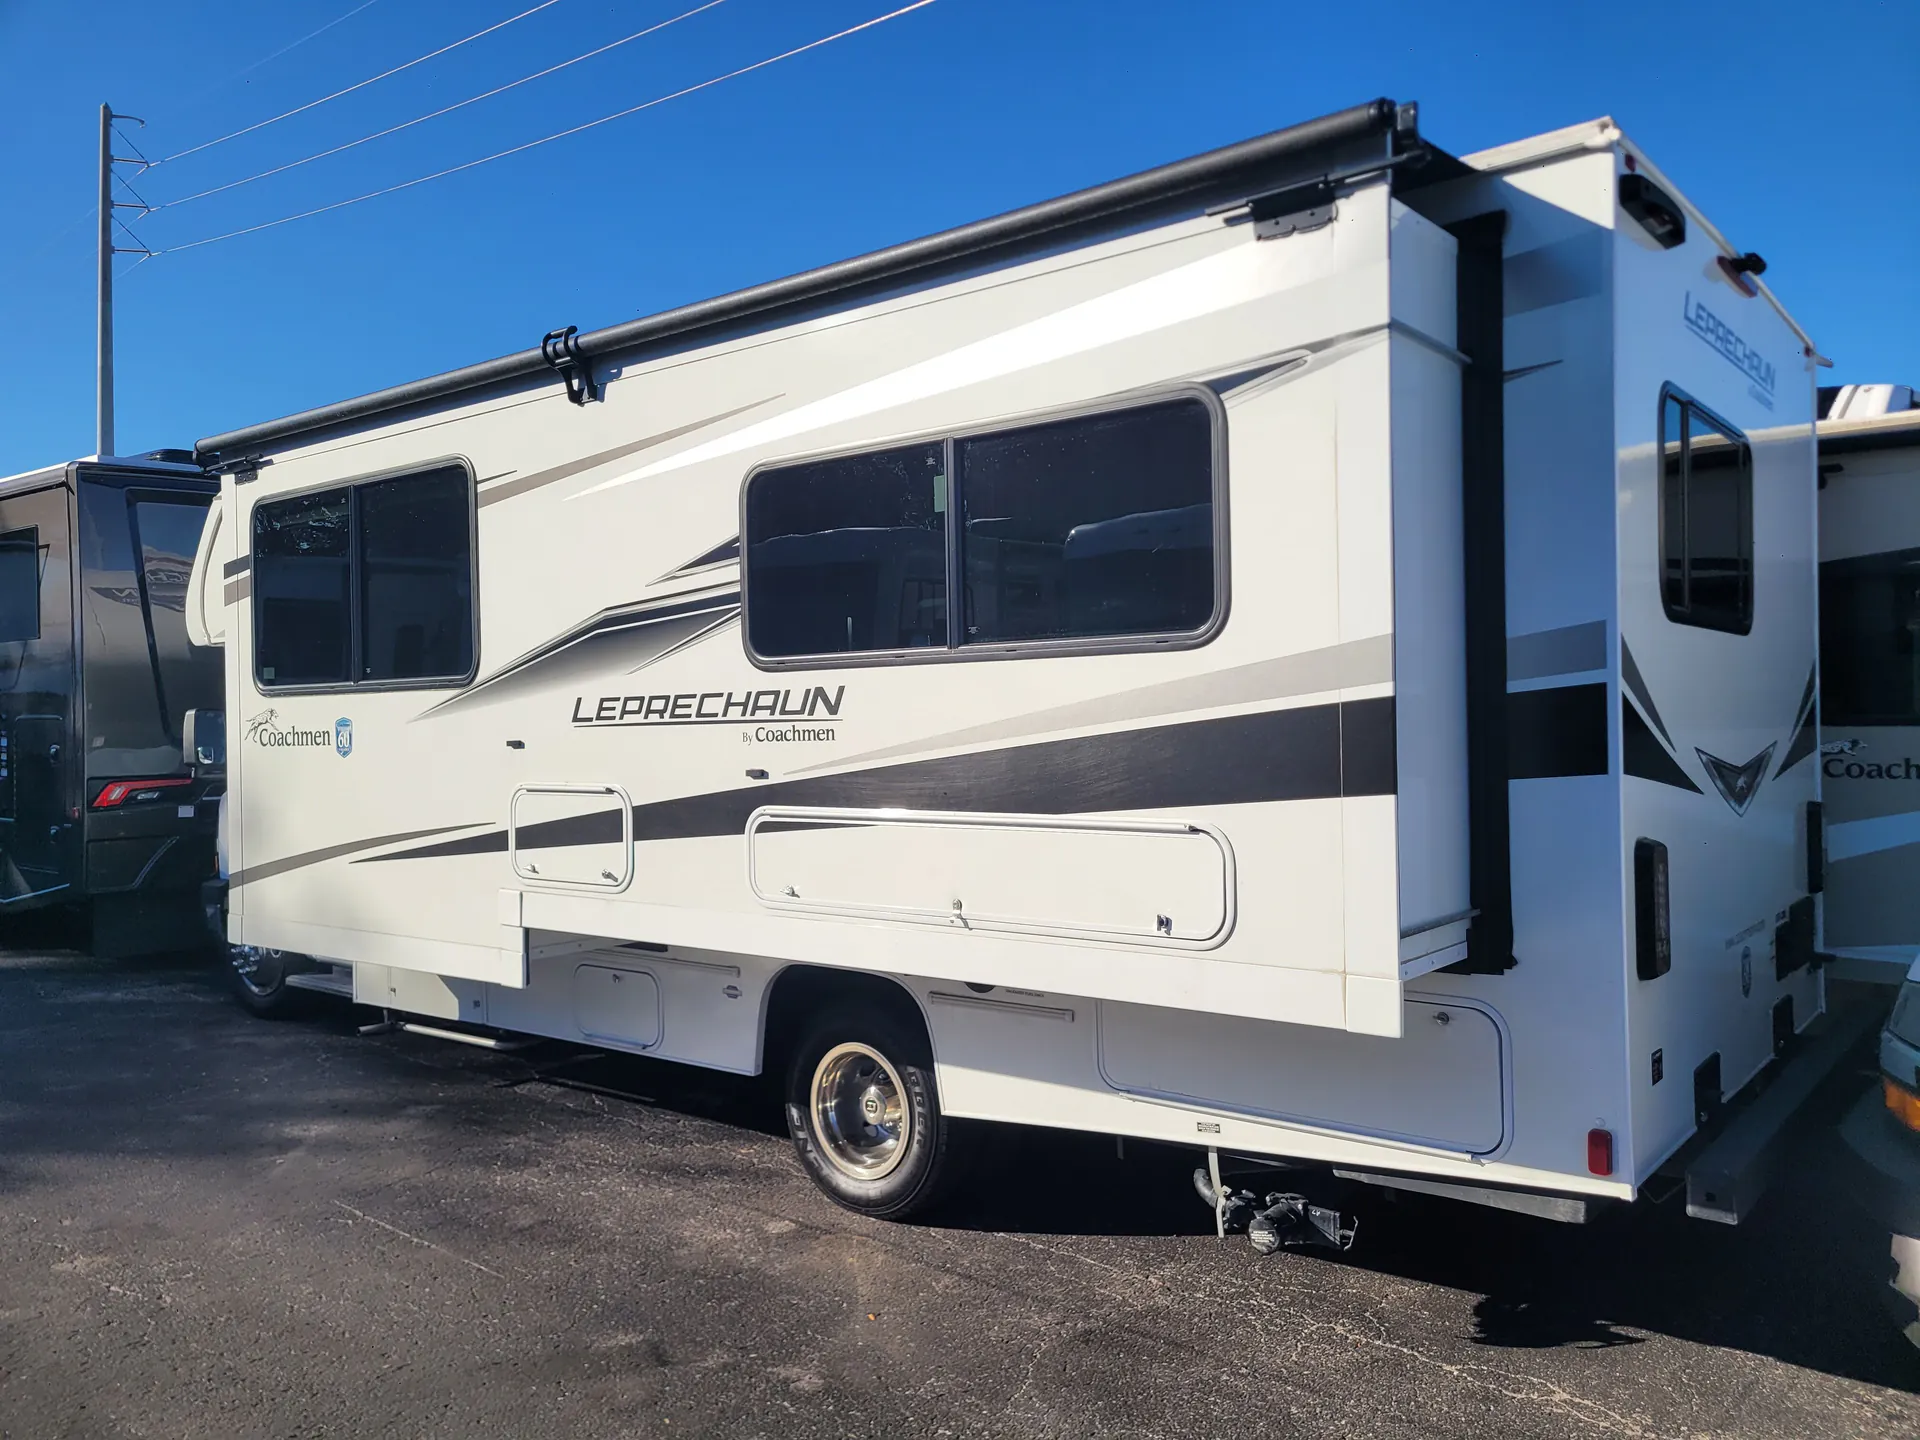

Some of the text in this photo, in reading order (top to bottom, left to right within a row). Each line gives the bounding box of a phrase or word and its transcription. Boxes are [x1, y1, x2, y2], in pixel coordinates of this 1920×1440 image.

[1683, 290, 1776, 391] LEPRECHAUN
[571, 685, 845, 723] LEPRECHAUN
[259, 726, 331, 747] Coachmen
[742, 725, 836, 746] By Coachmen
